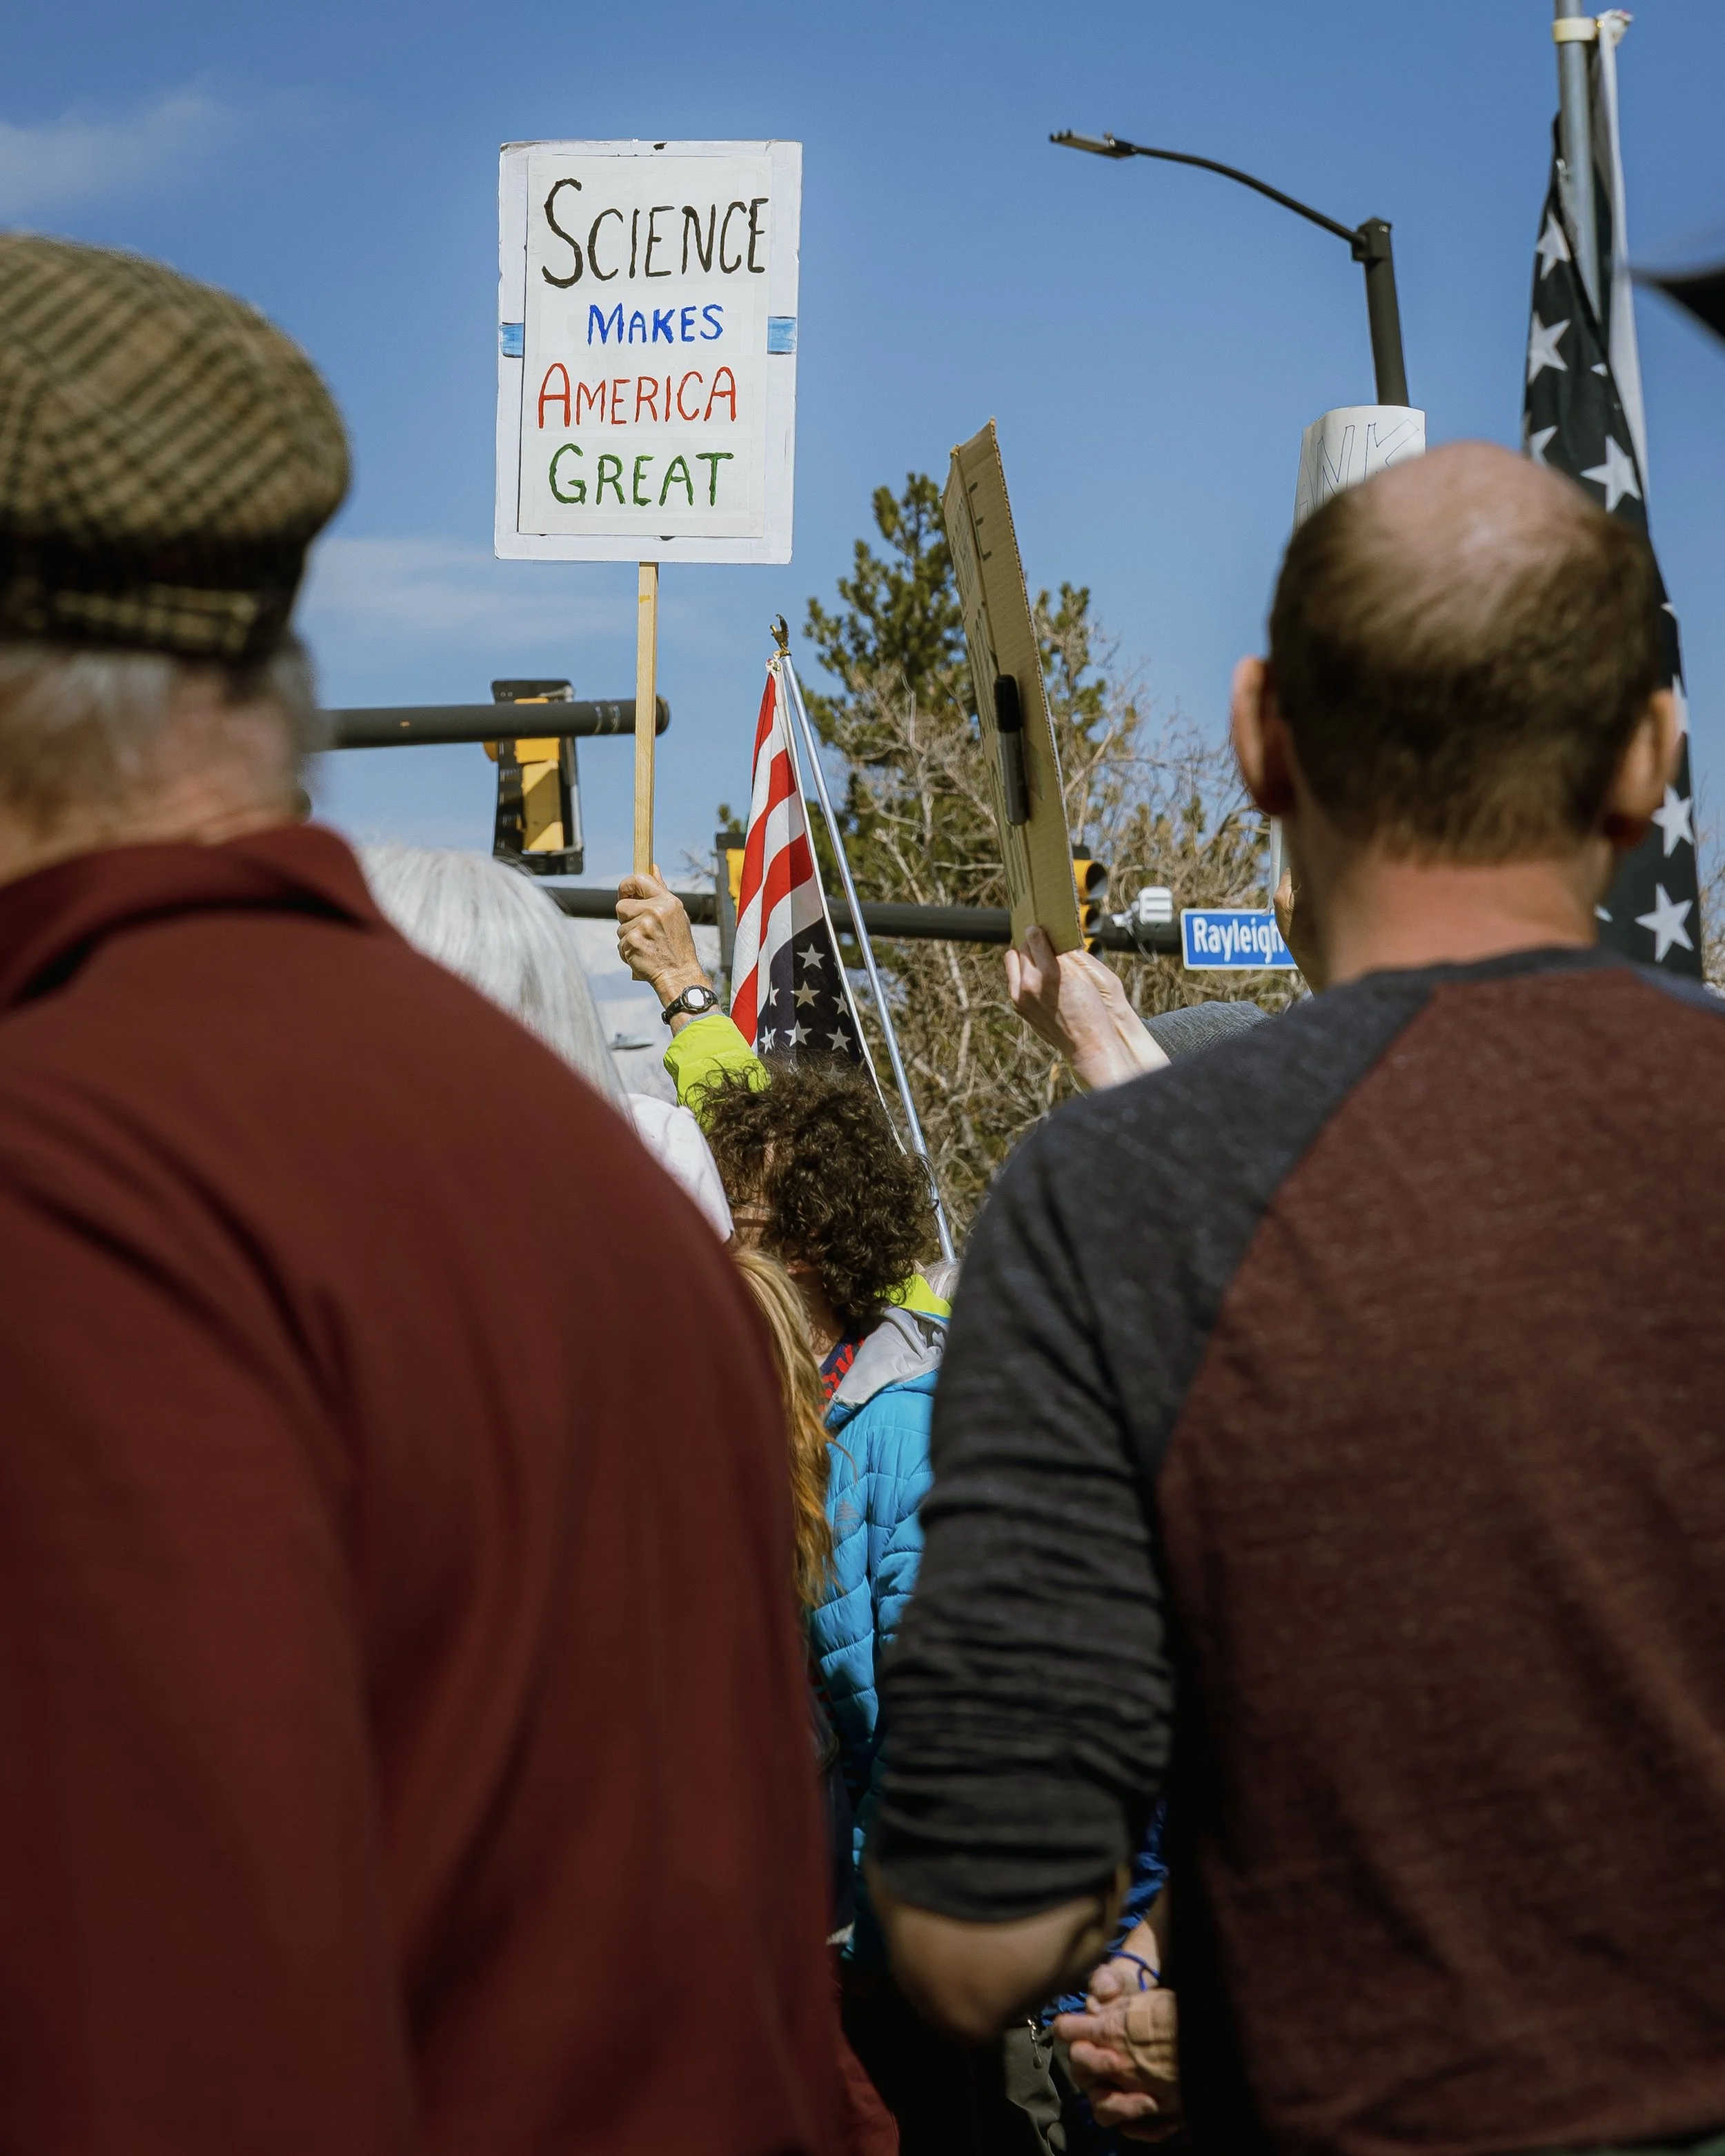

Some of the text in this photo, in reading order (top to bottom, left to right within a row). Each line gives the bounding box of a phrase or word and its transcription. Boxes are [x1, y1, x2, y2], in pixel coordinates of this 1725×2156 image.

[542, 178, 769, 288] SCIENCE
[588, 303, 724, 345] MAKES
[538, 363, 738, 428] AMERICA
[549, 443, 734, 506] GREAT
[1192, 917, 1285, 964] Rayleigh
